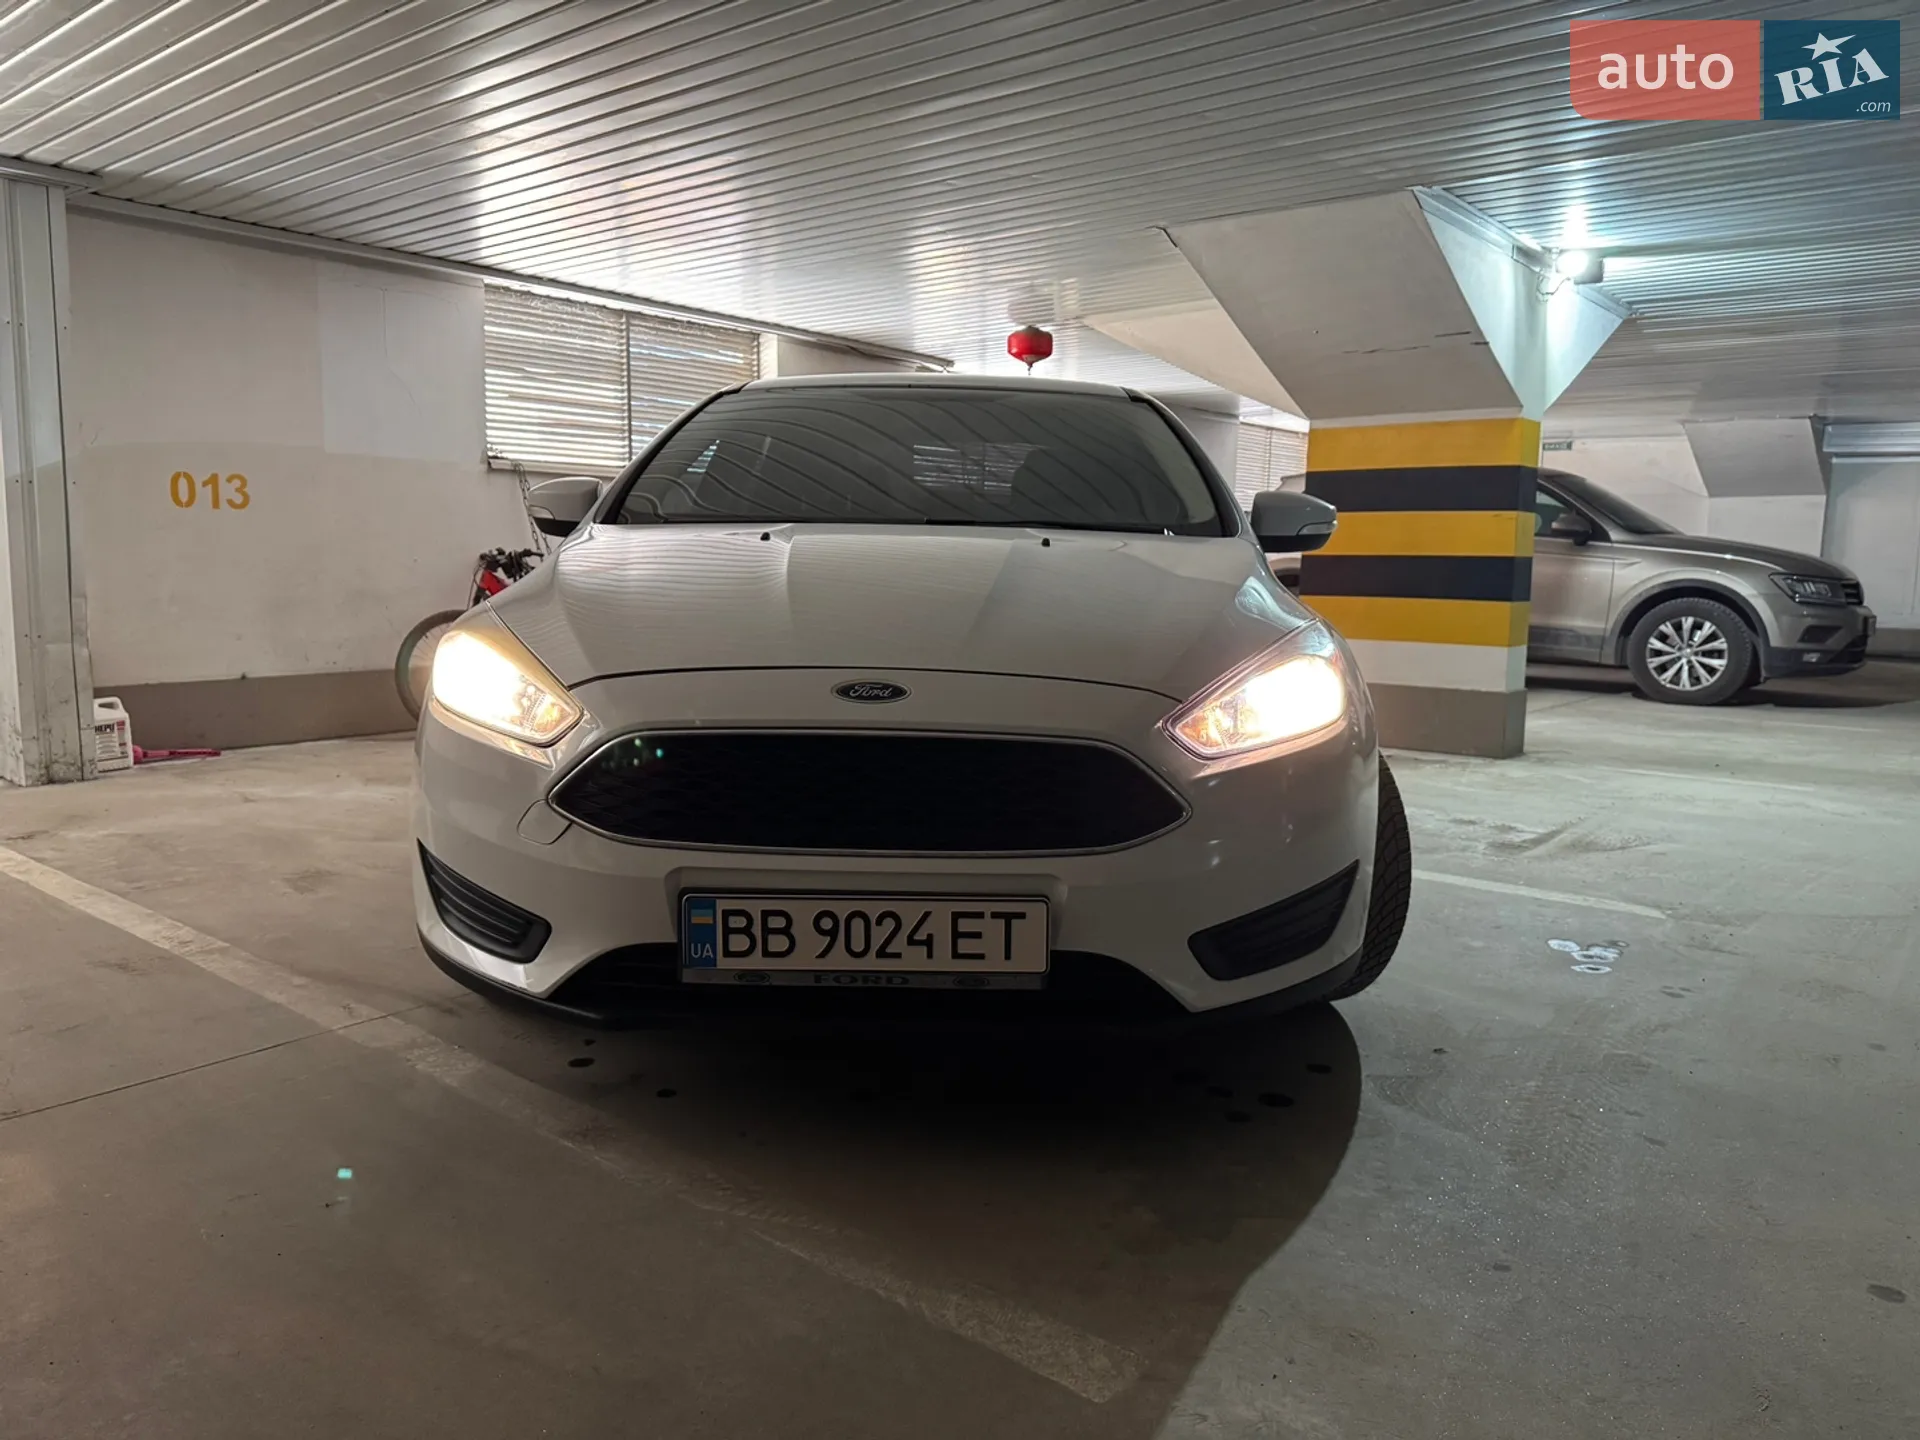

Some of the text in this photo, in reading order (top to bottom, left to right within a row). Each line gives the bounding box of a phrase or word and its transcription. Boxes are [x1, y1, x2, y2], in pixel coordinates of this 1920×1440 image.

[169, 470, 250, 510] 013
[849, 684, 893, 697] Ford
[721, 908, 1027, 961] BB 9024 ET
[690, 943, 714, 958] UA
[813, 972, 911, 986] FORD
